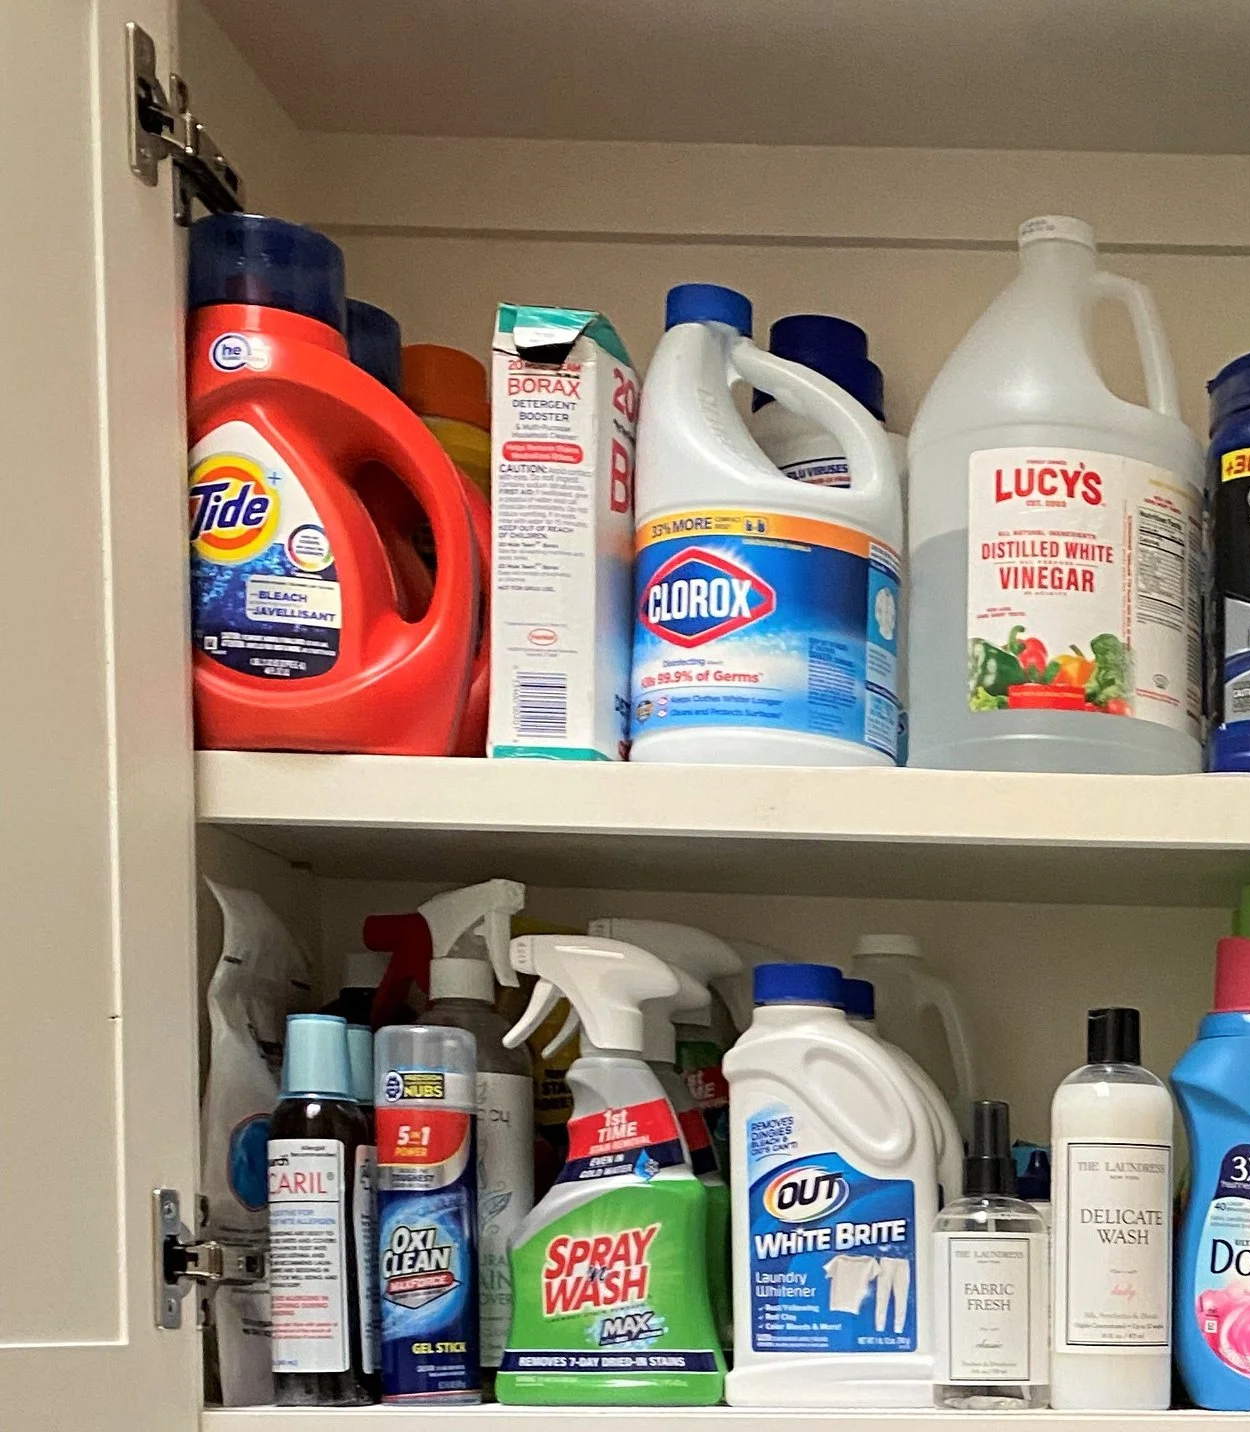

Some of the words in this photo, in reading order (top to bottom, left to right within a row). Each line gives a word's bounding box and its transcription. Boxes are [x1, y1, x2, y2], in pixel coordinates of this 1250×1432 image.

[221, 342, 241, 356] he
[507, 378, 582, 400] BORAX
[511, 399, 577, 411] DETERGENT
[519, 411, 570, 422] BOOSTER
[994, 462, 1103, 506] LUCY'S
[189, 482, 270, 542] Tide
[672, 517, 713, 532] MORE
[981, 540, 1060, 560] DISTILLED
[1064, 541, 1114, 564] WHITE
[999, 566, 1095, 593] VINEGAR
[259, 589, 308, 603] BLEACH
[648, 577, 752, 624] CLOROX
[696, 670, 710, 681] of
[713, 670, 760, 683] Germs
[404, 1085, 443, 1098] NUBS
[602, 1110, 629, 1128] 1st
[751, 1116, 794, 1131] REMOVES
[597, 1122, 638, 1144] TIME
[751, 1126, 793, 1141] DINGIES
[589, 1156, 611, 1167] EVEN
[1077, 1161, 1100, 1172] THE
[1104, 1161, 1166, 1174] LAUNDRESS
[579, 1168, 602, 1179] COLD
[777, 1171, 845, 1210] OUT
[1080, 1208, 1164, 1226] DELICATE
[391, 1226, 437, 1254] OXI
[754, 1227, 832, 1261] WHITE
[834, 1218, 907, 1252] BRITE
[1096, 1228, 1150, 1245] WASH
[544, 1225, 659, 1281] SPRAY
[382, 1246, 452, 1279] CLEAN
[755, 1271, 808, 1285] Laundry
[544, 1266, 649, 1315] WASH
[755, 1285, 816, 1298] Whitener
[964, 1283, 1015, 1296] FABRIC
[967, 1299, 1012, 1311] FRESH
[601, 1311, 655, 1339] MAX
[412, 1342, 434, 1355] GEL
[435, 1341, 467, 1354] STICK
[518, 1356, 567, 1367] REMOVES
[568, 1356, 600, 1368] 7-DAY
[601, 1356, 648, 1368] DRIED-IN
[649, 1356, 686, 1367] STAINS
